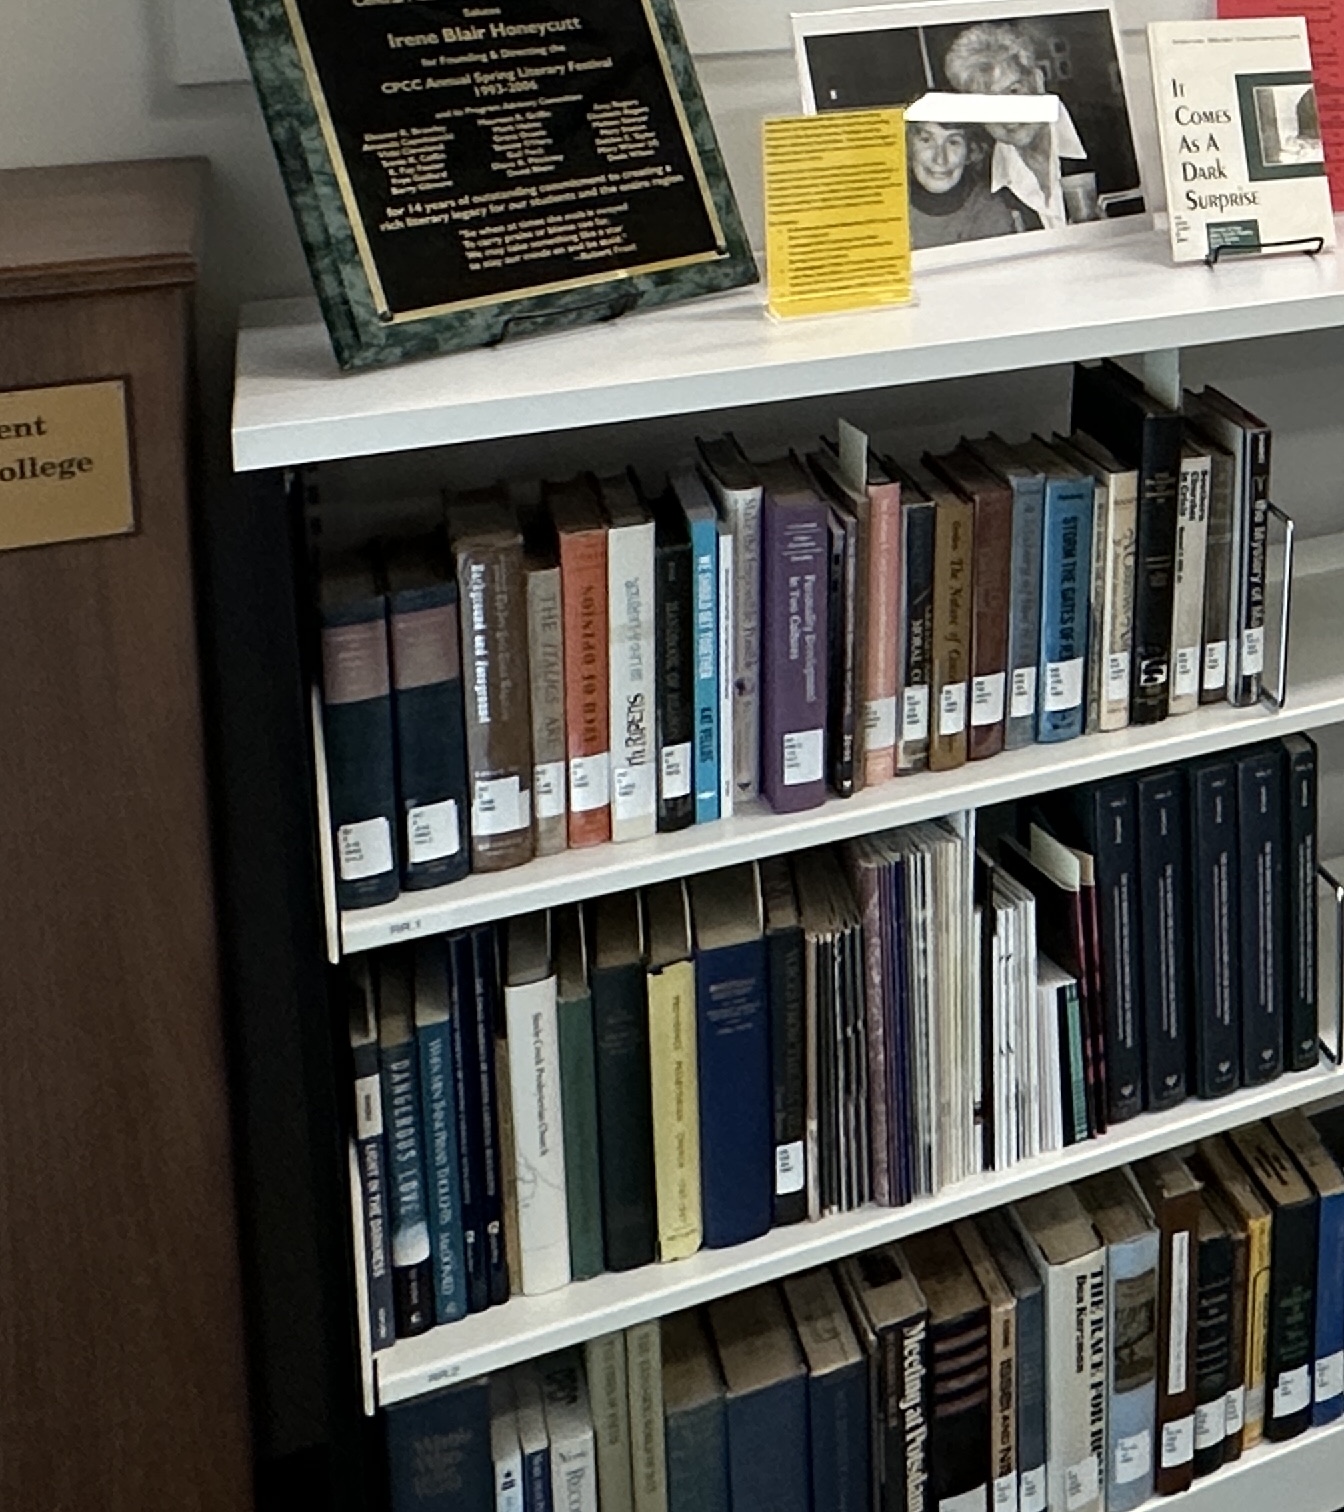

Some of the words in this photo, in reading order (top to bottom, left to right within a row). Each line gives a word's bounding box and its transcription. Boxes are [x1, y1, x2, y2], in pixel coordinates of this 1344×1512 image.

[386, 32, 440, 50] Irene
[441, 25, 486, 44] Blair
[488, 16, 584, 38] Honeycutt
[380, 79, 424, 95] CPCC
[424, 72, 472, 89] Annual
[472, 70, 516, 85] Spring
[516, 65, 566, 79] Literary
[566, 56, 614, 72] Festival
[1171, 78, 1185, 98] It
[1174, 104, 1232, 126] Comes
[1178, 135, 1200, 153] As
[1206, 133, 1220, 152] A
[1181, 157, 1228, 182] Dark
[378, 219, 405, 232] rich
[405, 213, 450, 228] literary
[450, 207, 487, 220] legacy
[488, 202, 505, 214] for
[528, 191, 577, 208] students
[386, 206, 405, 218] for
[407, 203, 423, 214] 14
[423, 199, 457, 214] years
[457, 195, 470, 206] of
[470, 186, 537, 203] outstanding
[538, 174, 607, 193] commitment
[607, 172, 621, 182] to
[1185, 185, 1260, 214] Surprise
[0, 415, 47, 440] ent
[0, 456, 93, 482] ollege
[1178, 484, 1189, 517] Crisis
[1187, 470, 1198, 522] Churches
[1197, 469, 1208, 522] Southern
[1061, 516, 1078, 558] STORM
[1247, 525, 1265, 584] Mystery
[696, 554, 711, 571] WE
[948, 557, 963, 579] The
[1059, 561, 1076, 584] THE
[697, 572, 712, 610] SHOULD
[801, 574, 816, 632] Personality
[947, 587, 962, 626] Nature
[1059, 587, 1075, 625] GATES
[539, 592, 558, 632] THE
[580, 583, 597, 664] OPINION
[697, 610, 712, 629] GET
[787, 614, 800, 660] Cultures
[909, 618, 923, 664] MORAL
[943, 632, 962, 645] of
[1058, 627, 1074, 642] OF
[541, 644, 560, 704] ITALICS
[697, 630, 713, 680] TOGETHER
[802, 633, 817, 703] Development
[531, 1039, 544, 1066] Creek
[428, 1072, 445, 1100] MEN
[531, 1067, 546, 1122] Presbyterian
[389, 1058, 416, 1163] DANGEROUS
[430, 1099, 446, 1131] THINK
[537, 1122, 548, 1157] Church
[363, 1143, 379, 1178] LIGHT
[366, 1178, 380, 1192] IN
[396, 1167, 419, 1216] LOVE
[434, 1167, 451, 1225] THOUGHTS
[367, 1192, 381, 1219] THE
[369, 1219, 384, 1279] DARKNESS
[1074, 1274, 1087, 1305] Dan
[1088, 1265, 1104, 1315] THE
[896, 1320, 927, 1406] Meeting
[1088, 1317, 1104, 1377] RACE
[902, 1405, 926, 1429] at
[1088, 1379, 1104, 1425] FOR
[999, 1413, 1009, 1445] AND
[902, 1426, 928, 1512] Potsdam
